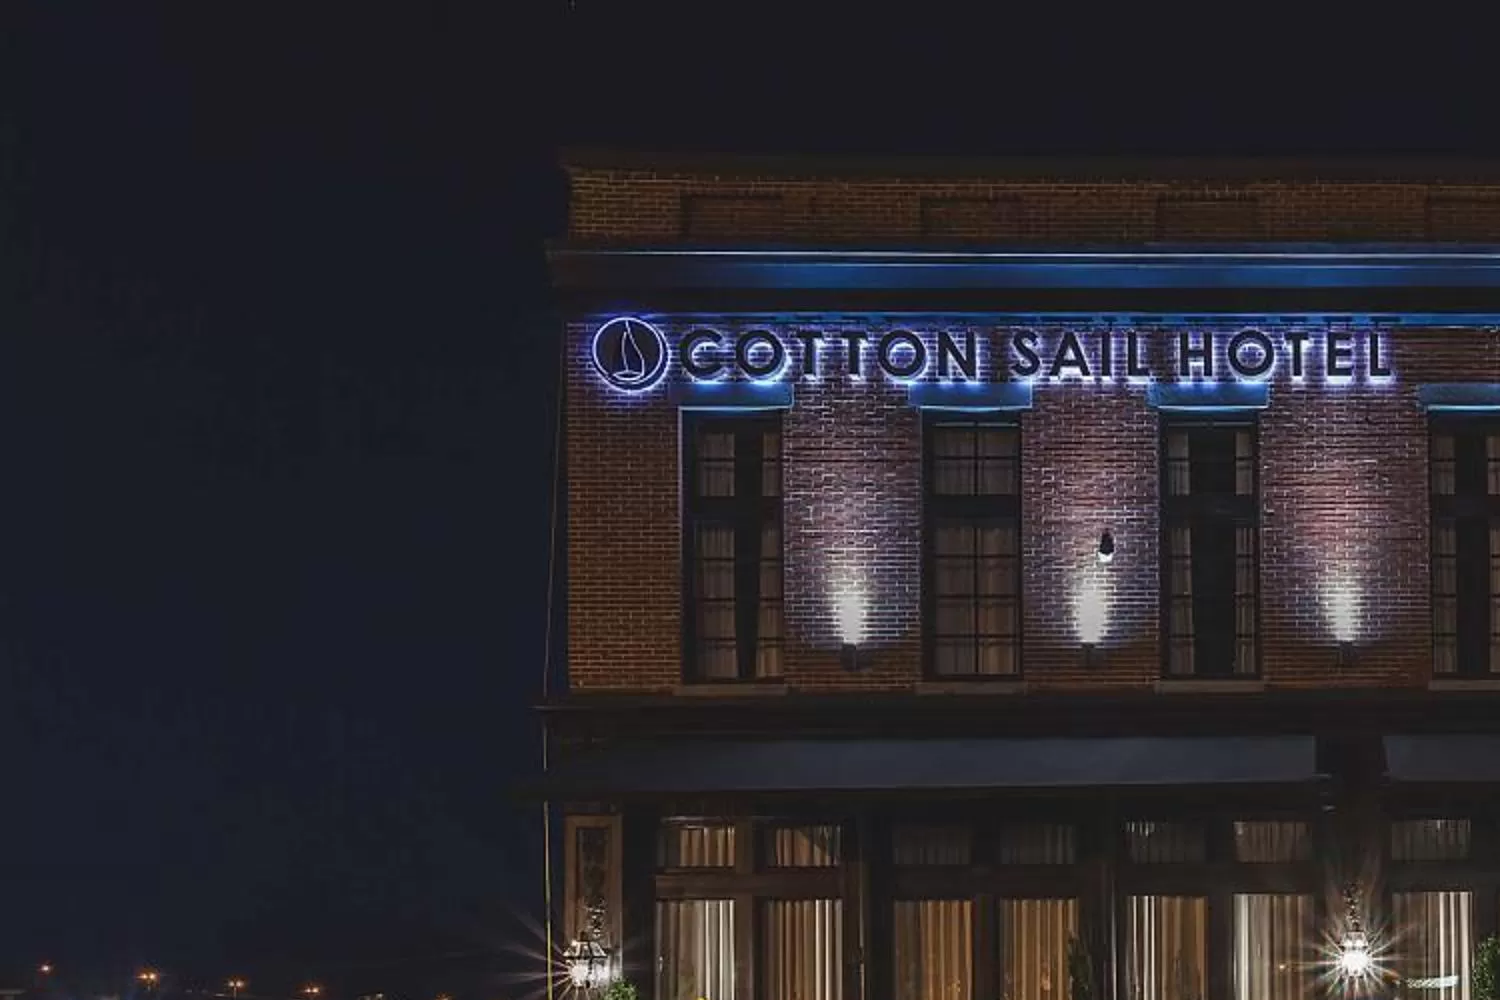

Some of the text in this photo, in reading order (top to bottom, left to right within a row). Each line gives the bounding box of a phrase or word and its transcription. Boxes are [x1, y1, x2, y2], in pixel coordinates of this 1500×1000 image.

[679, 329, 1391, 379] COTTON SAIL HOTEL
